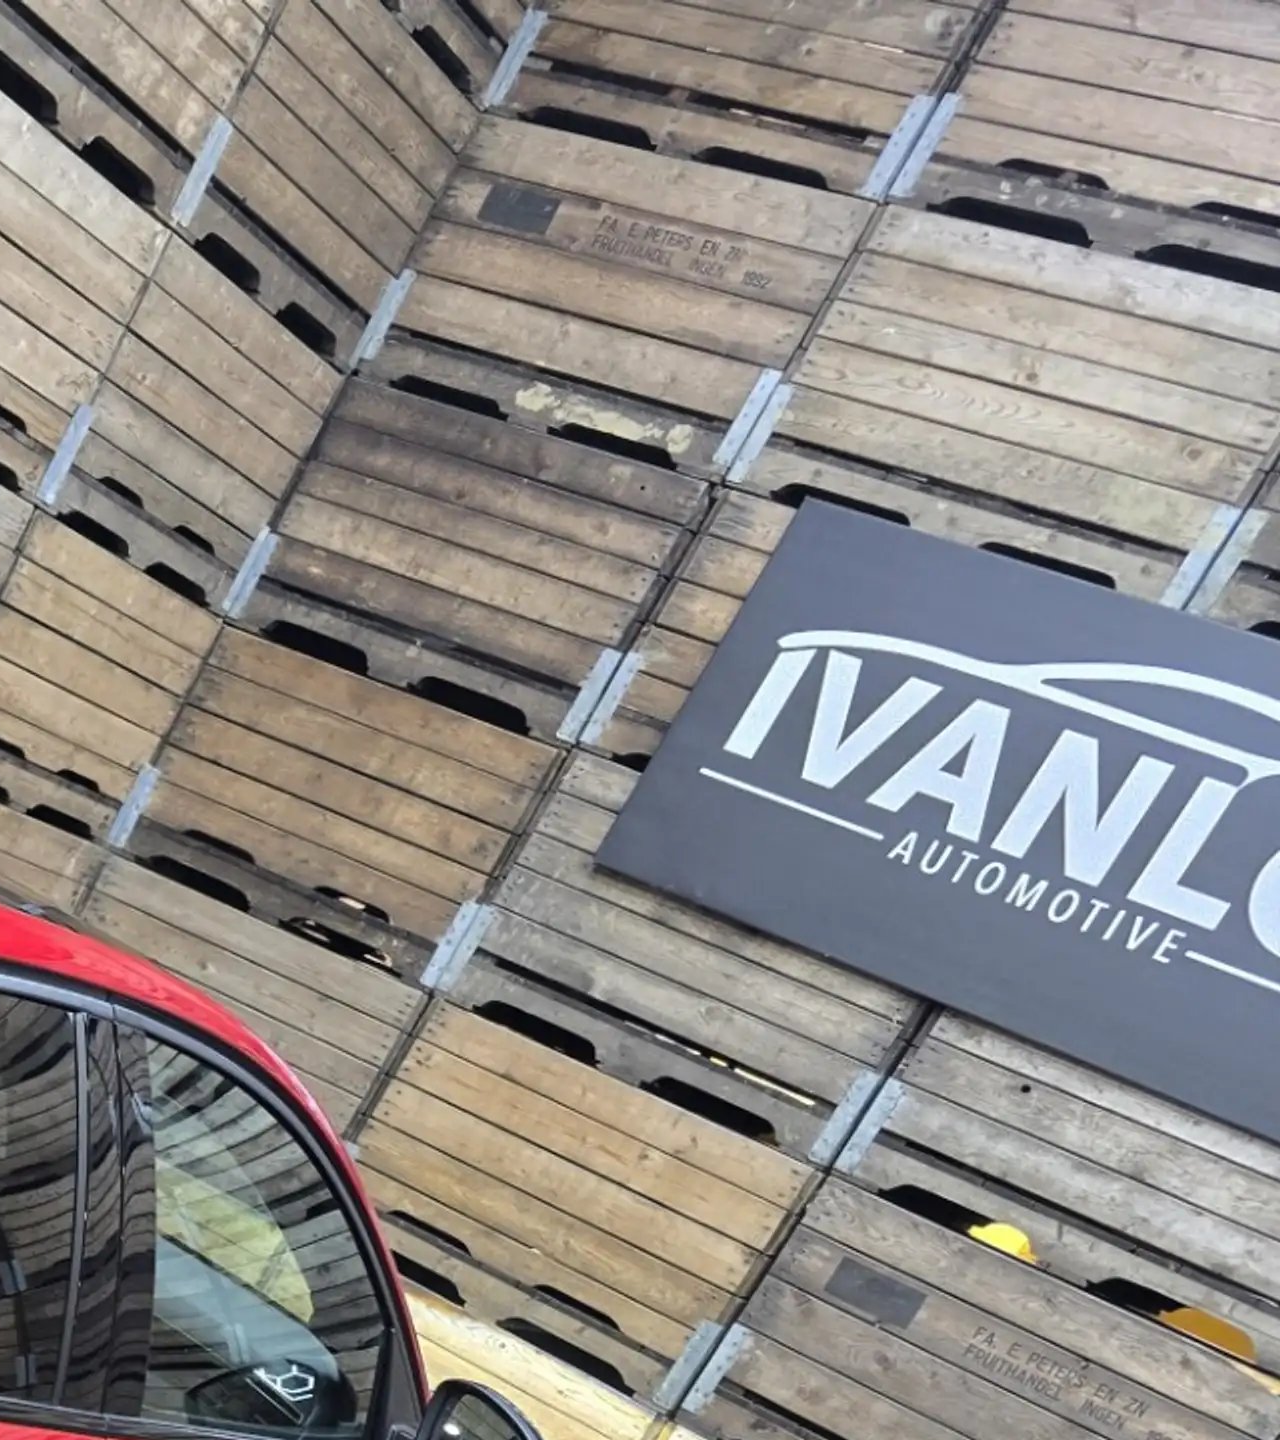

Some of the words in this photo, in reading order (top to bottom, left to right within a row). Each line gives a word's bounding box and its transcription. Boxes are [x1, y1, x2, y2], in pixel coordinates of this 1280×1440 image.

[887, 831, 1186, 964] AUTOMOTIVE
[962, 1345, 1064, 1402] FRUITHANDEL
[1077, 1399, 1128, 1431] INGEN
[1006, 1341, 1023, 1359] E
[1026, 1352, 1089, 1390] PETERS
[1095, 1384, 1119, 1403] EN
[1122, 1397, 1151, 1419] ZN
